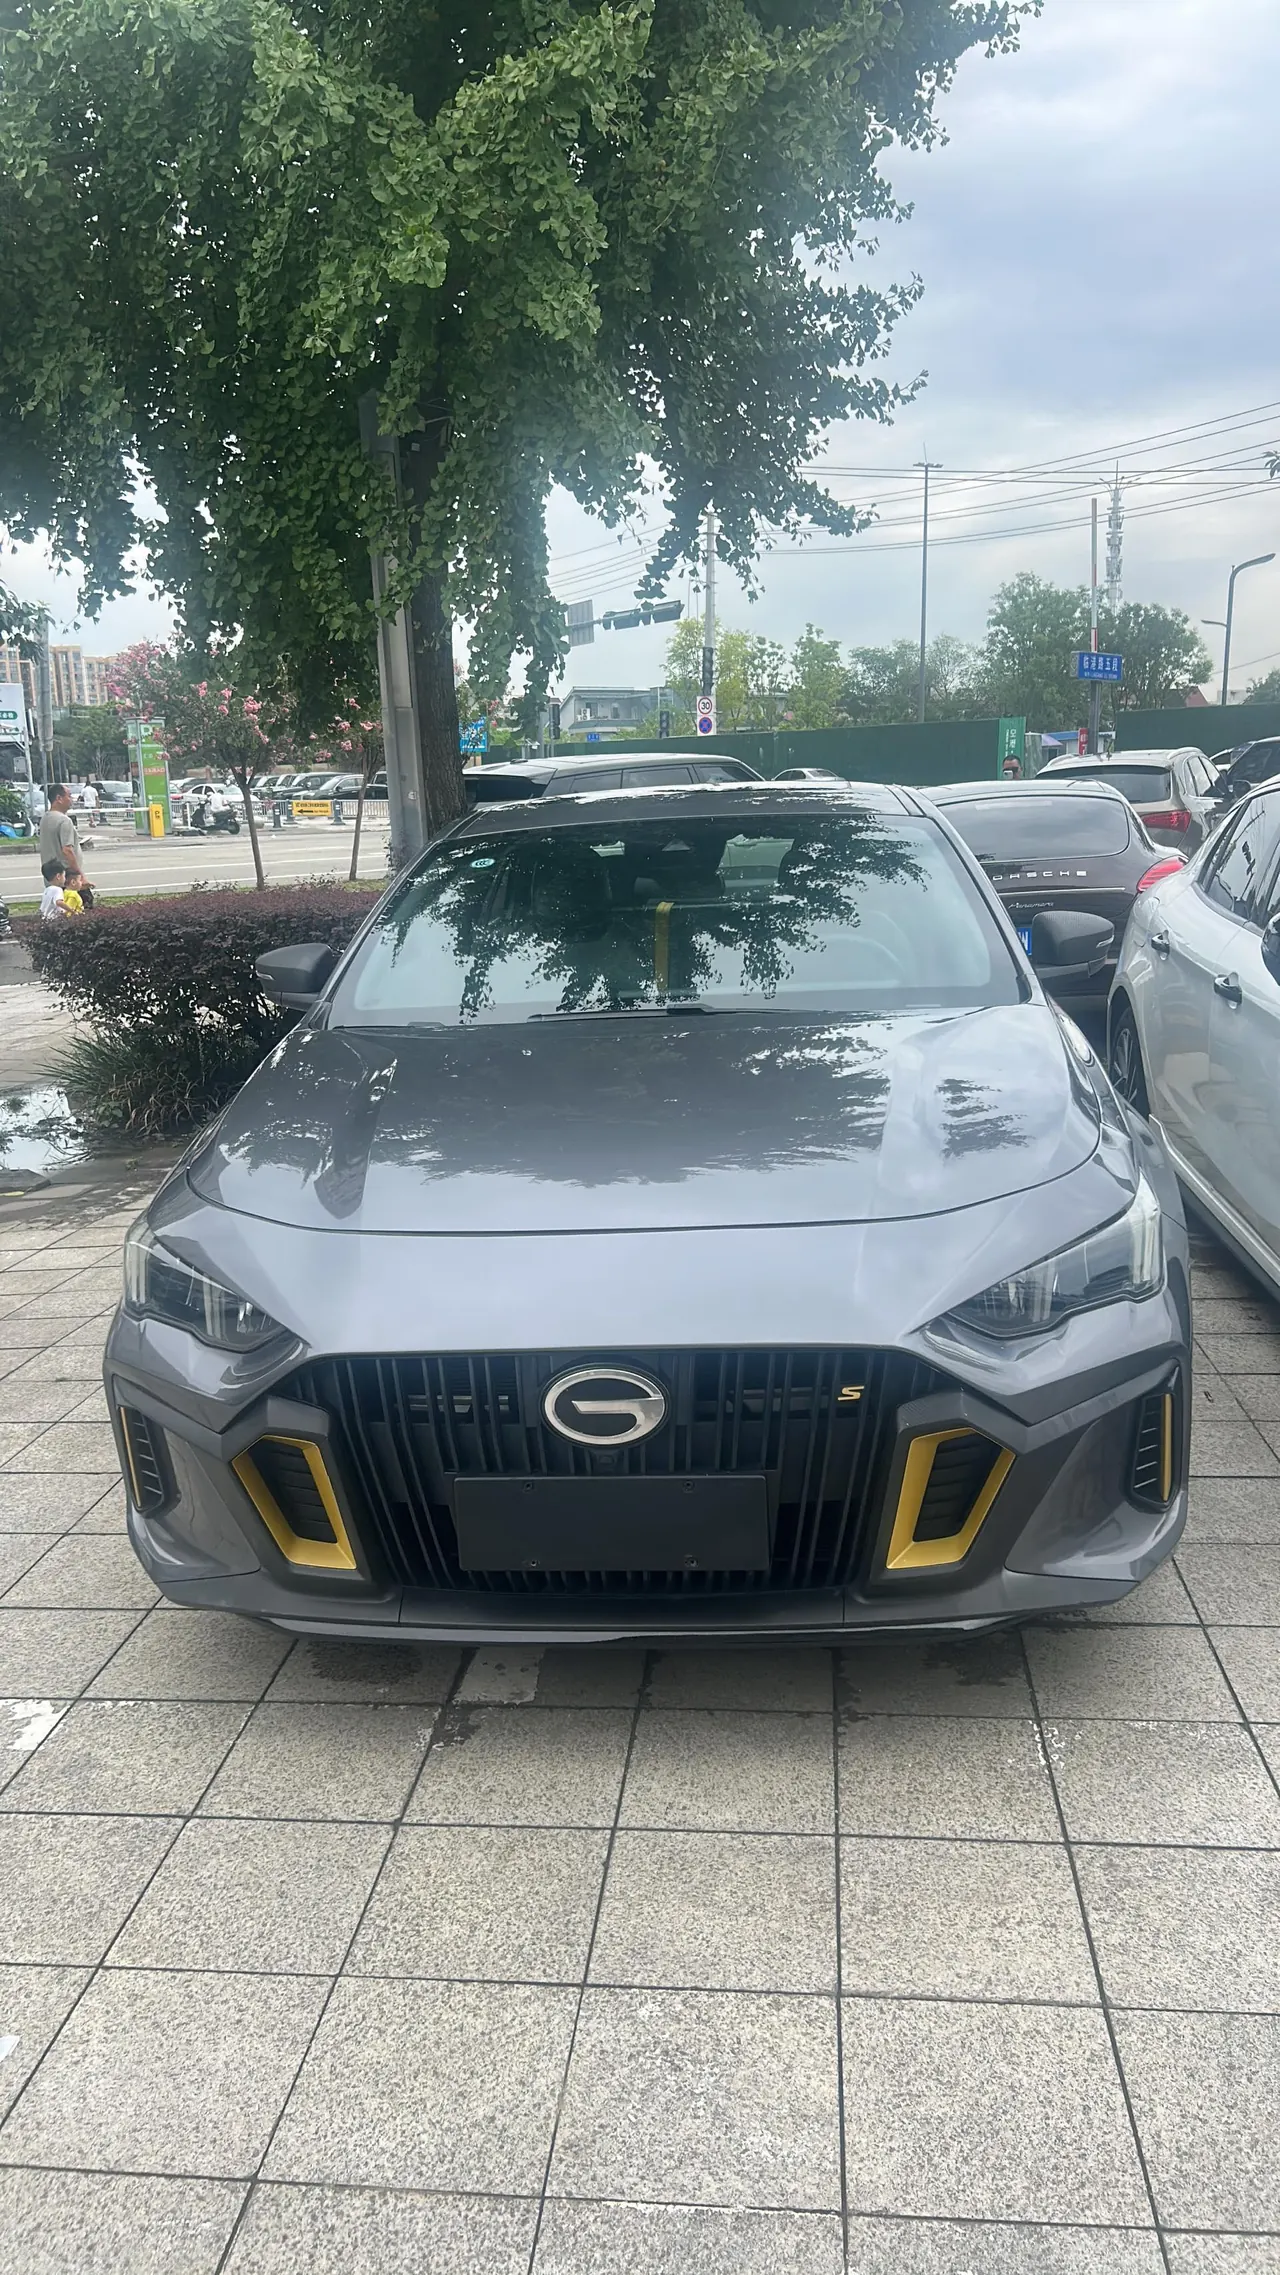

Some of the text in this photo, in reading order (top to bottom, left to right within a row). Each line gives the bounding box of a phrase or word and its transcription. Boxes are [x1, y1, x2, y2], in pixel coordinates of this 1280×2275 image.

[701, 702, 710, 710] 30
[992, 870, 1087, 881] ORSCHE
[837, 1385, 865, 1401] S
